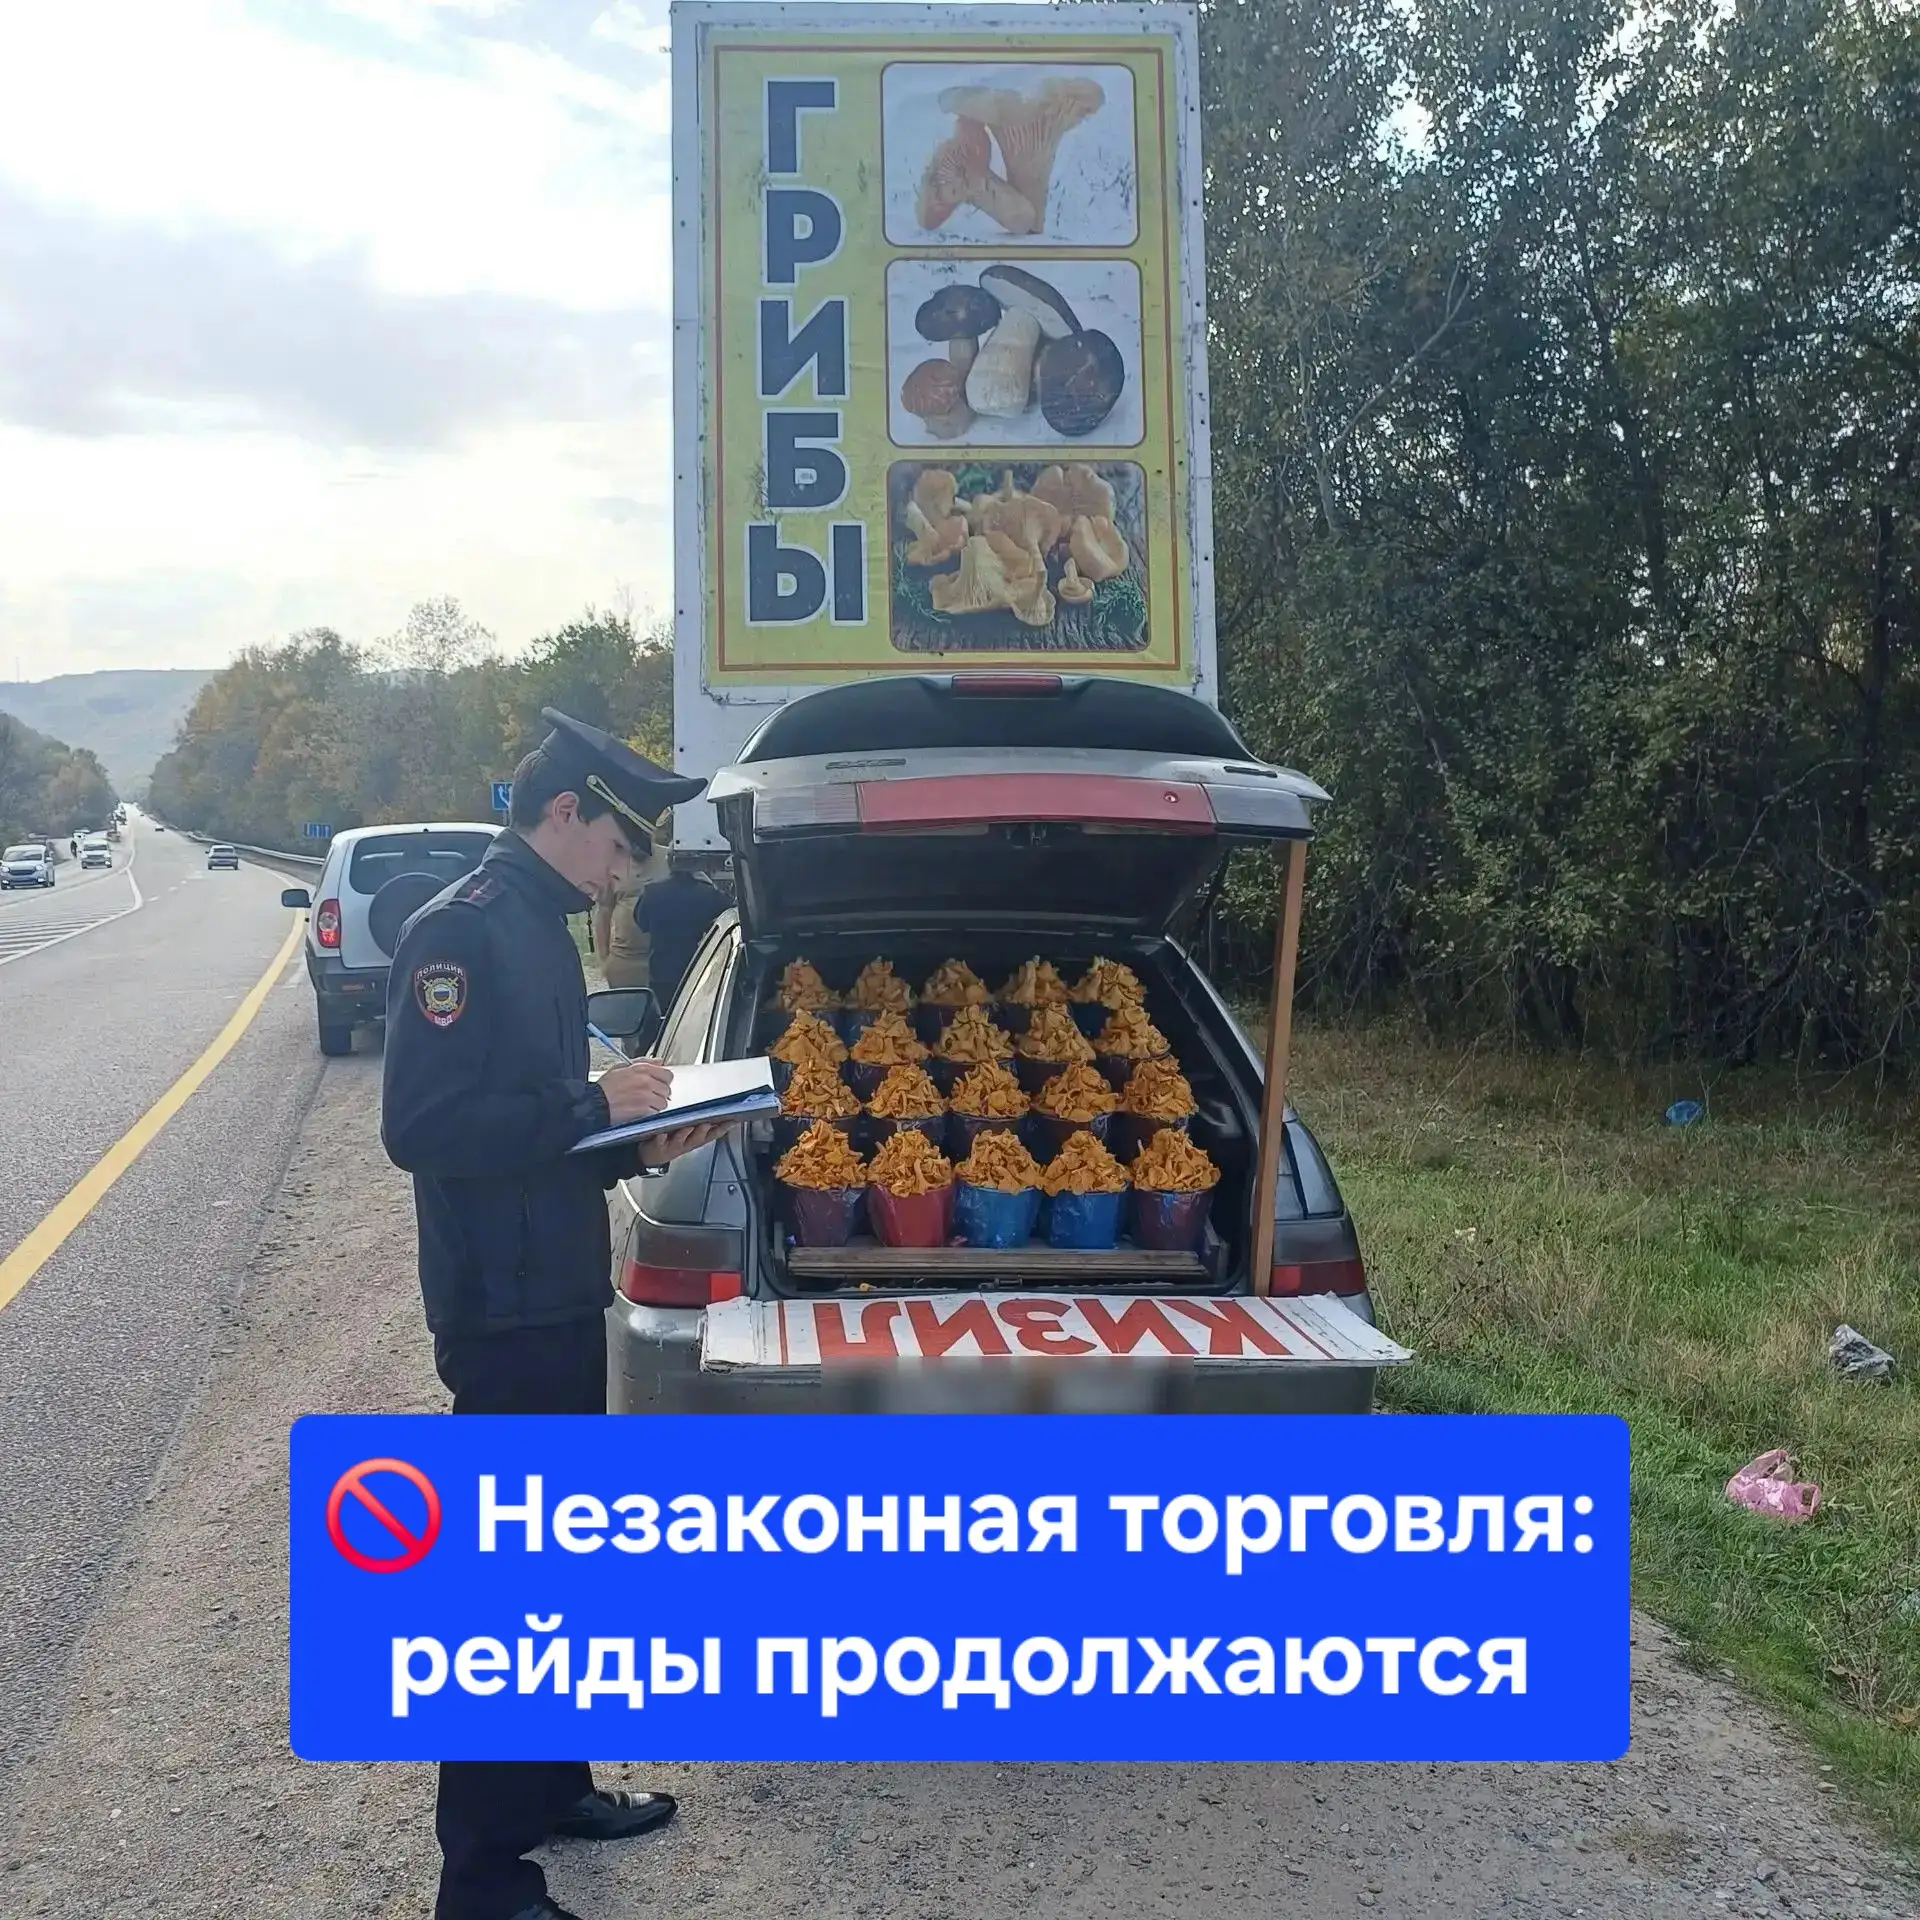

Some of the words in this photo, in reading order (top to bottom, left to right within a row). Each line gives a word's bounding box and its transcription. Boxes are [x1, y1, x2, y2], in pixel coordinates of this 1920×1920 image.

[746, 78, 868, 624] ГРИБЫ
[416, 962, 464, 979] ПОЛИЦИЯ
[812, 1299, 1295, 1357] КИЗИЛ
